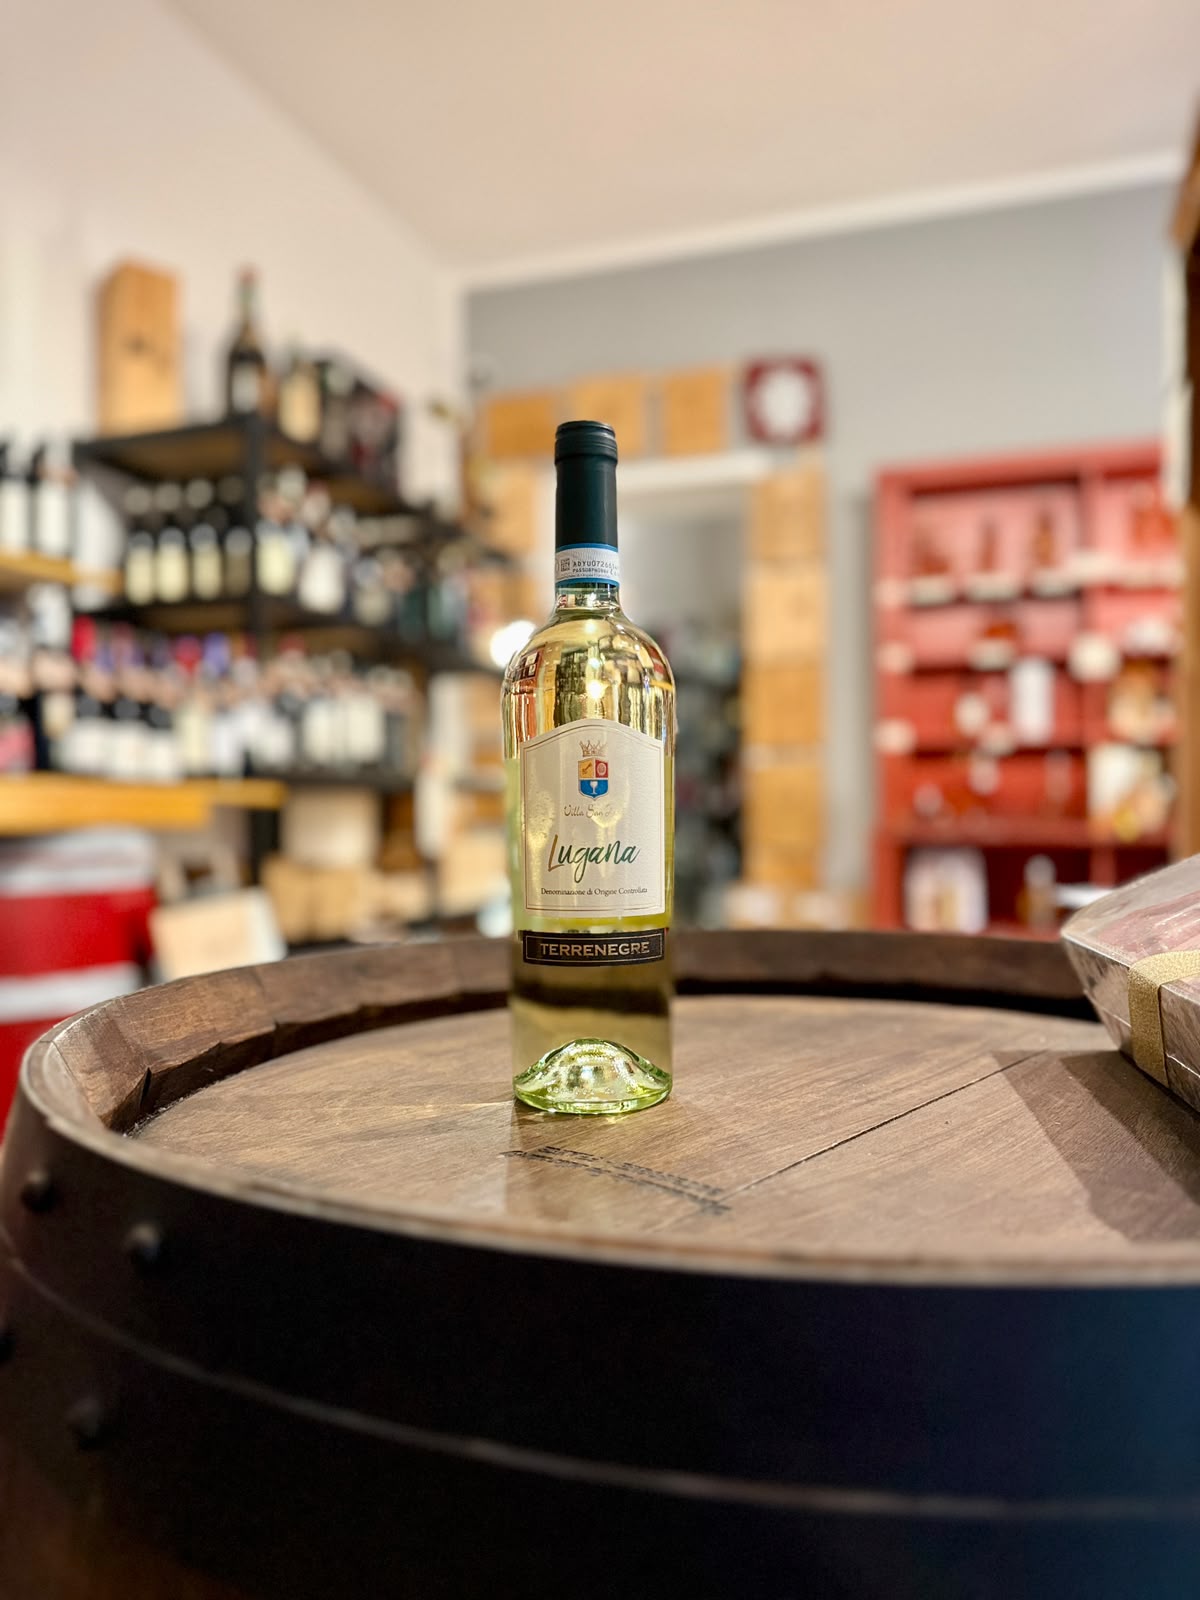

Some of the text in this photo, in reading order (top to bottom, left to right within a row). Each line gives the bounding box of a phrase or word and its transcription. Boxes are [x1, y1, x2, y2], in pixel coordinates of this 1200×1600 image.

[564, 804, 584, 817] Villa
[548, 834, 640, 884] Lugana
[540, 886, 648, 898] Denominazione di Origine Controllata
[540, 942, 650, 957] TERRENEGRE
